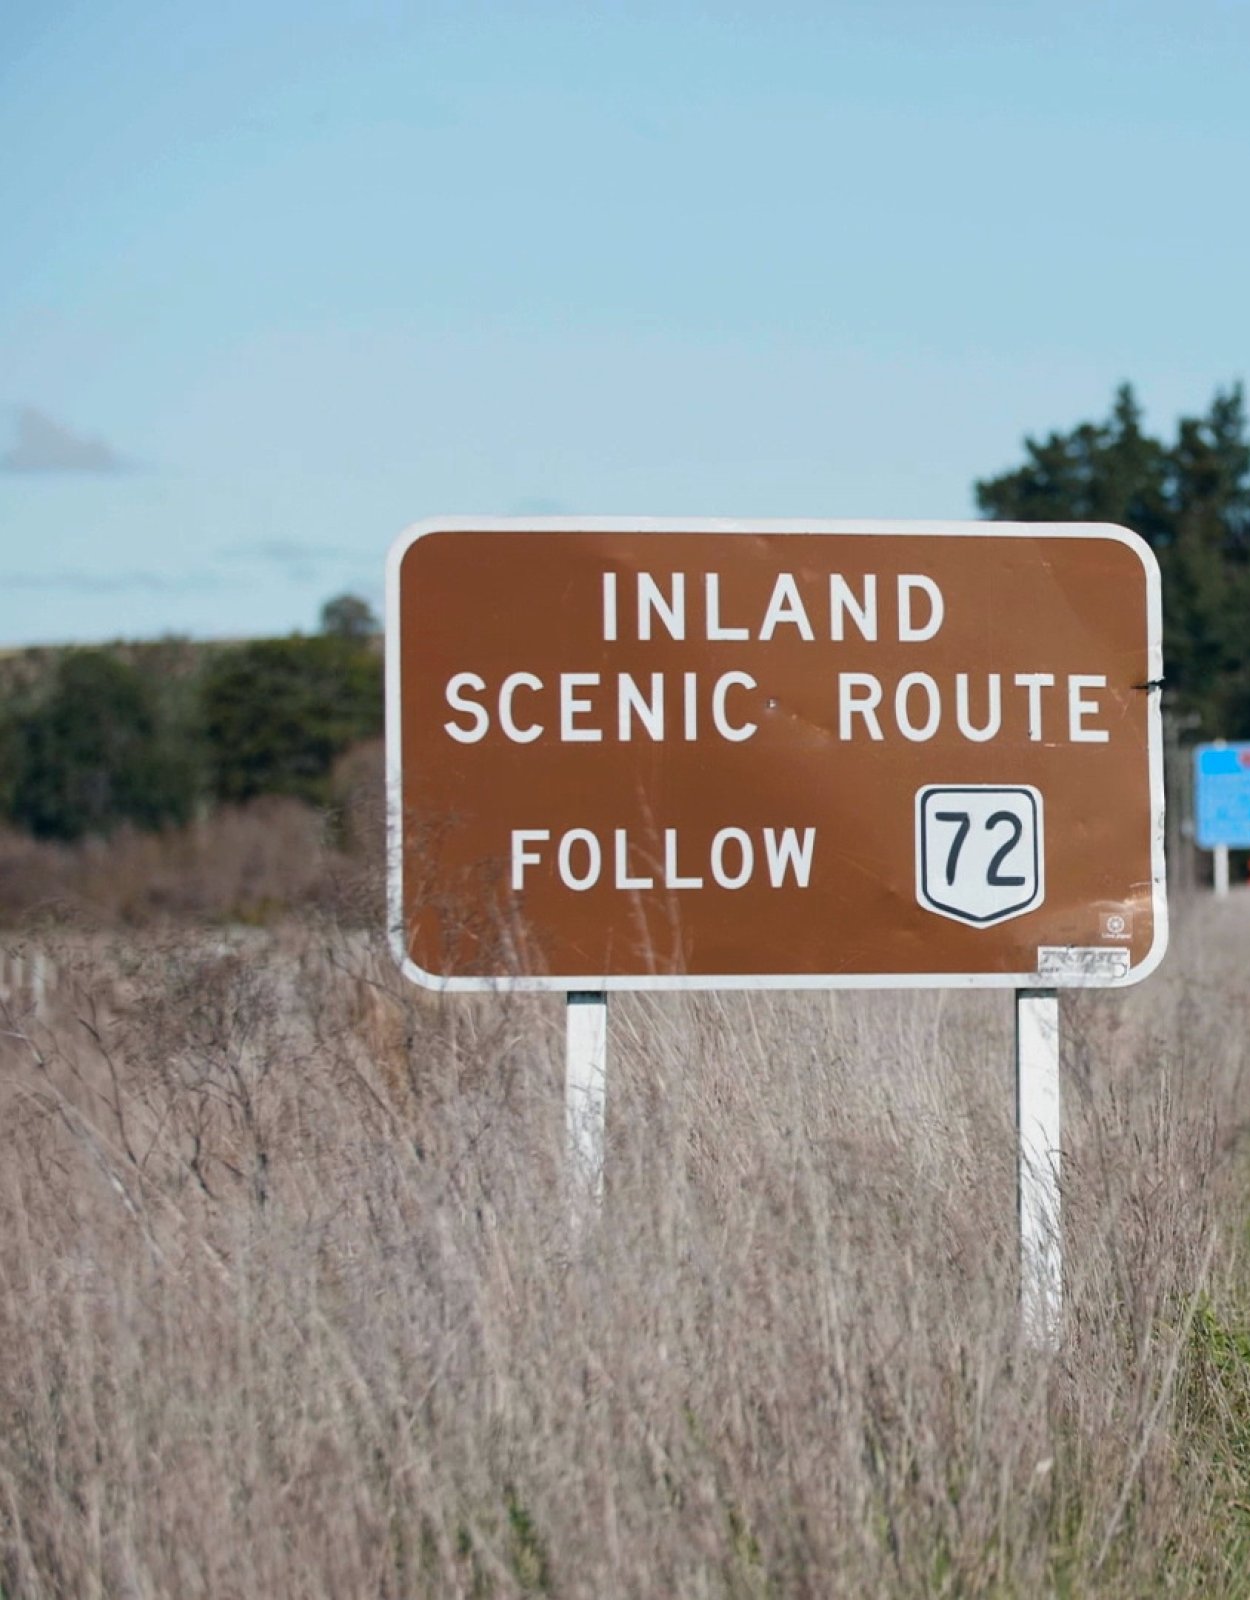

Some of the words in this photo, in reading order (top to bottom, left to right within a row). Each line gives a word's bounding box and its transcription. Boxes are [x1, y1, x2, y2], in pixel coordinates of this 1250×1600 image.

[603, 572, 945, 642] INLAND
[444, 670, 758, 744] SCENIC
[838, 672, 1110, 743] ROUTE
[511, 827, 816, 891] FOLLOW
[935, 811, 1026, 887] 72
